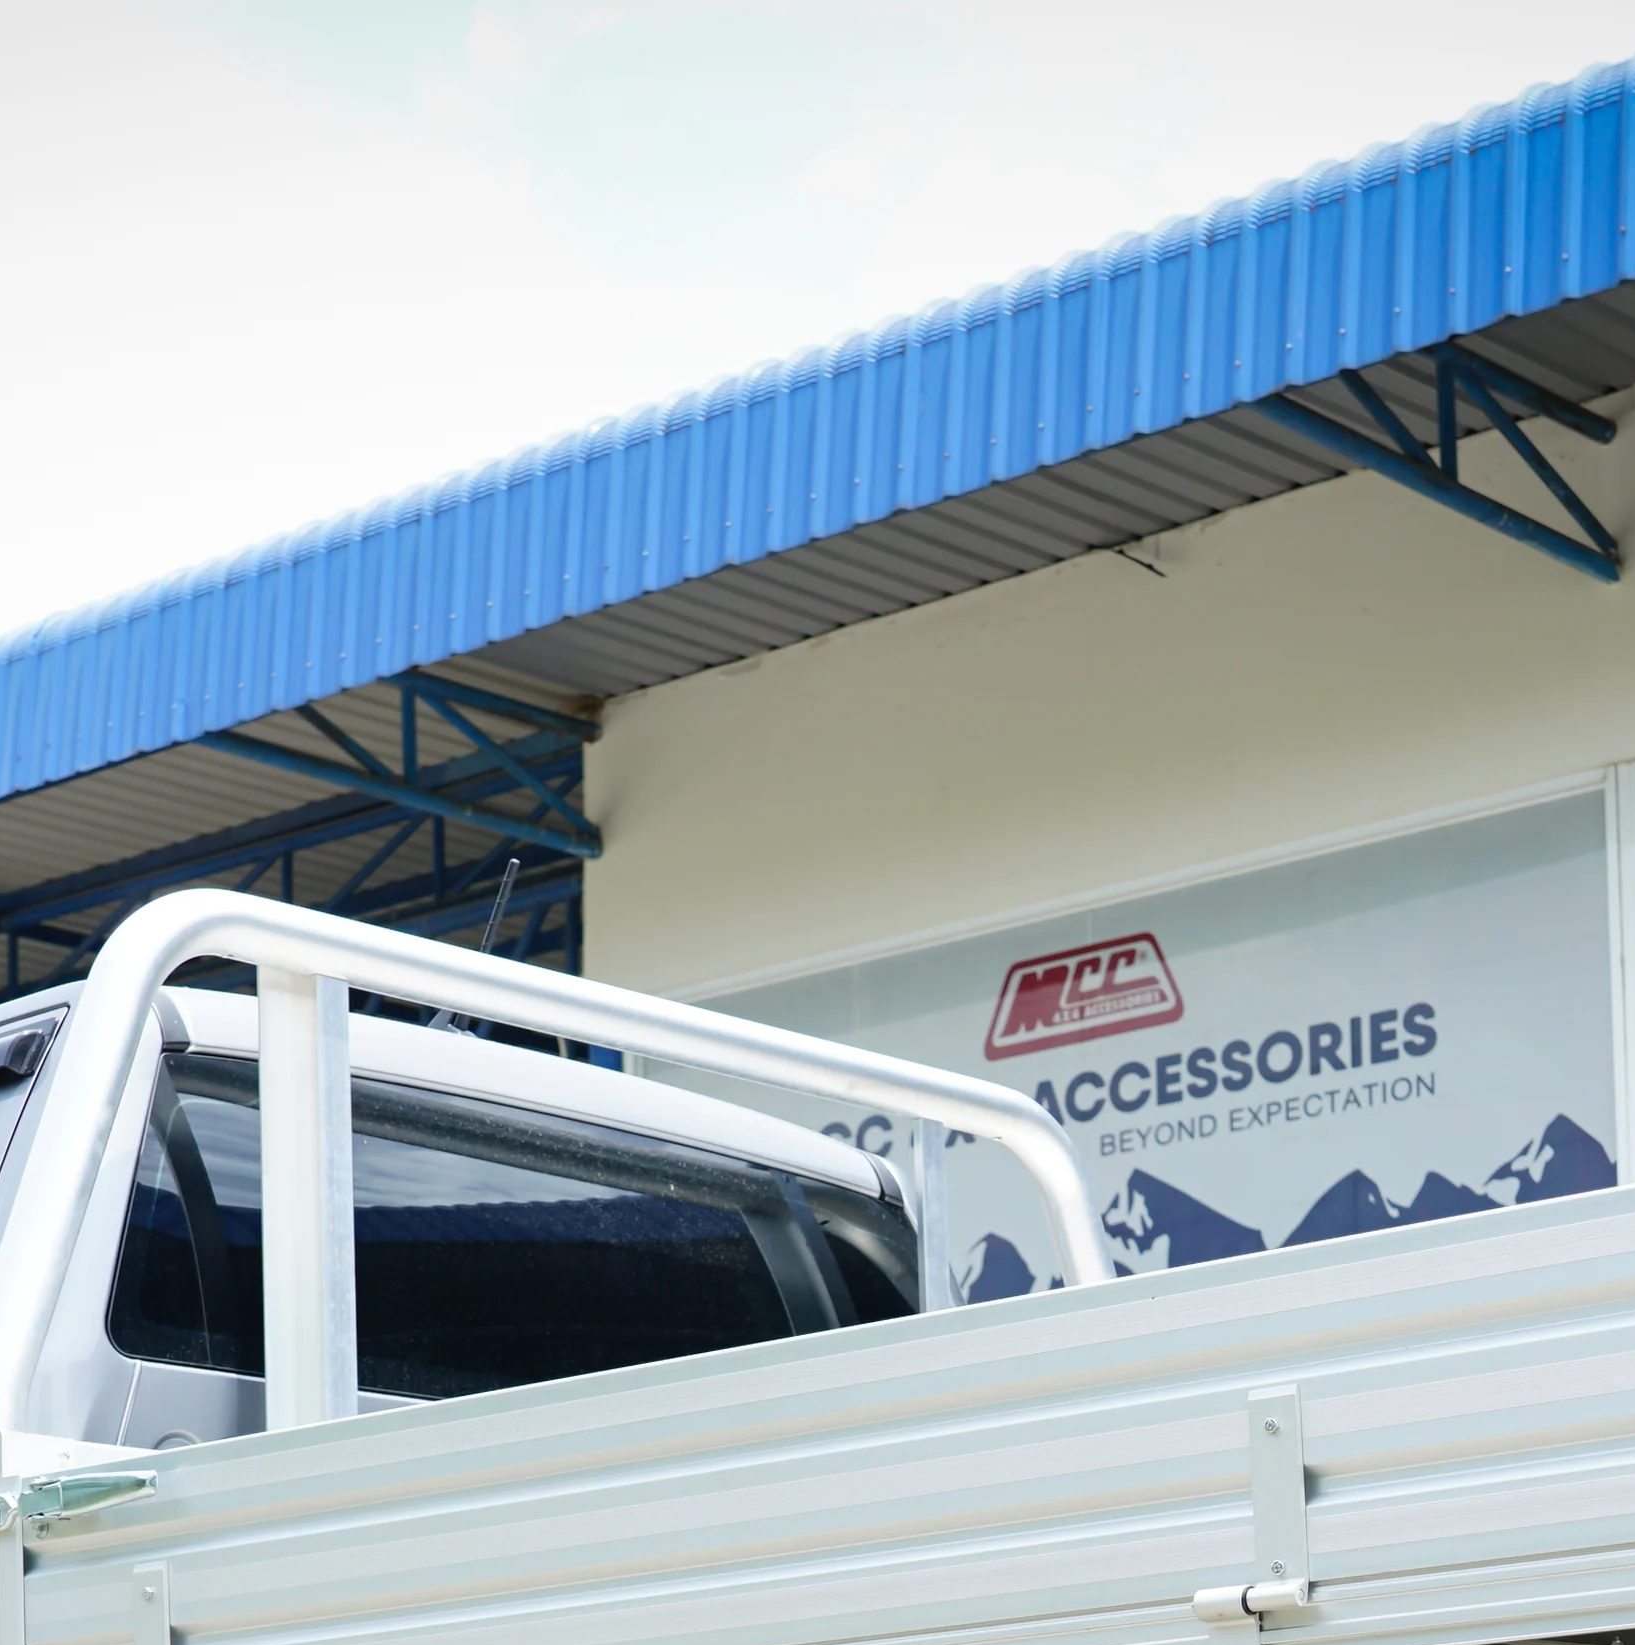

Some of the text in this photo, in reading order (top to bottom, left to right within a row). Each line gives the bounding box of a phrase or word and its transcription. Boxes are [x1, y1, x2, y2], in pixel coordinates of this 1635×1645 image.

[999, 948, 1160, 1039] MCC
[1033, 1002, 1438, 1127] ACCESSORIES
[1099, 1072, 1436, 1157] BEYOND EXPECTATION
